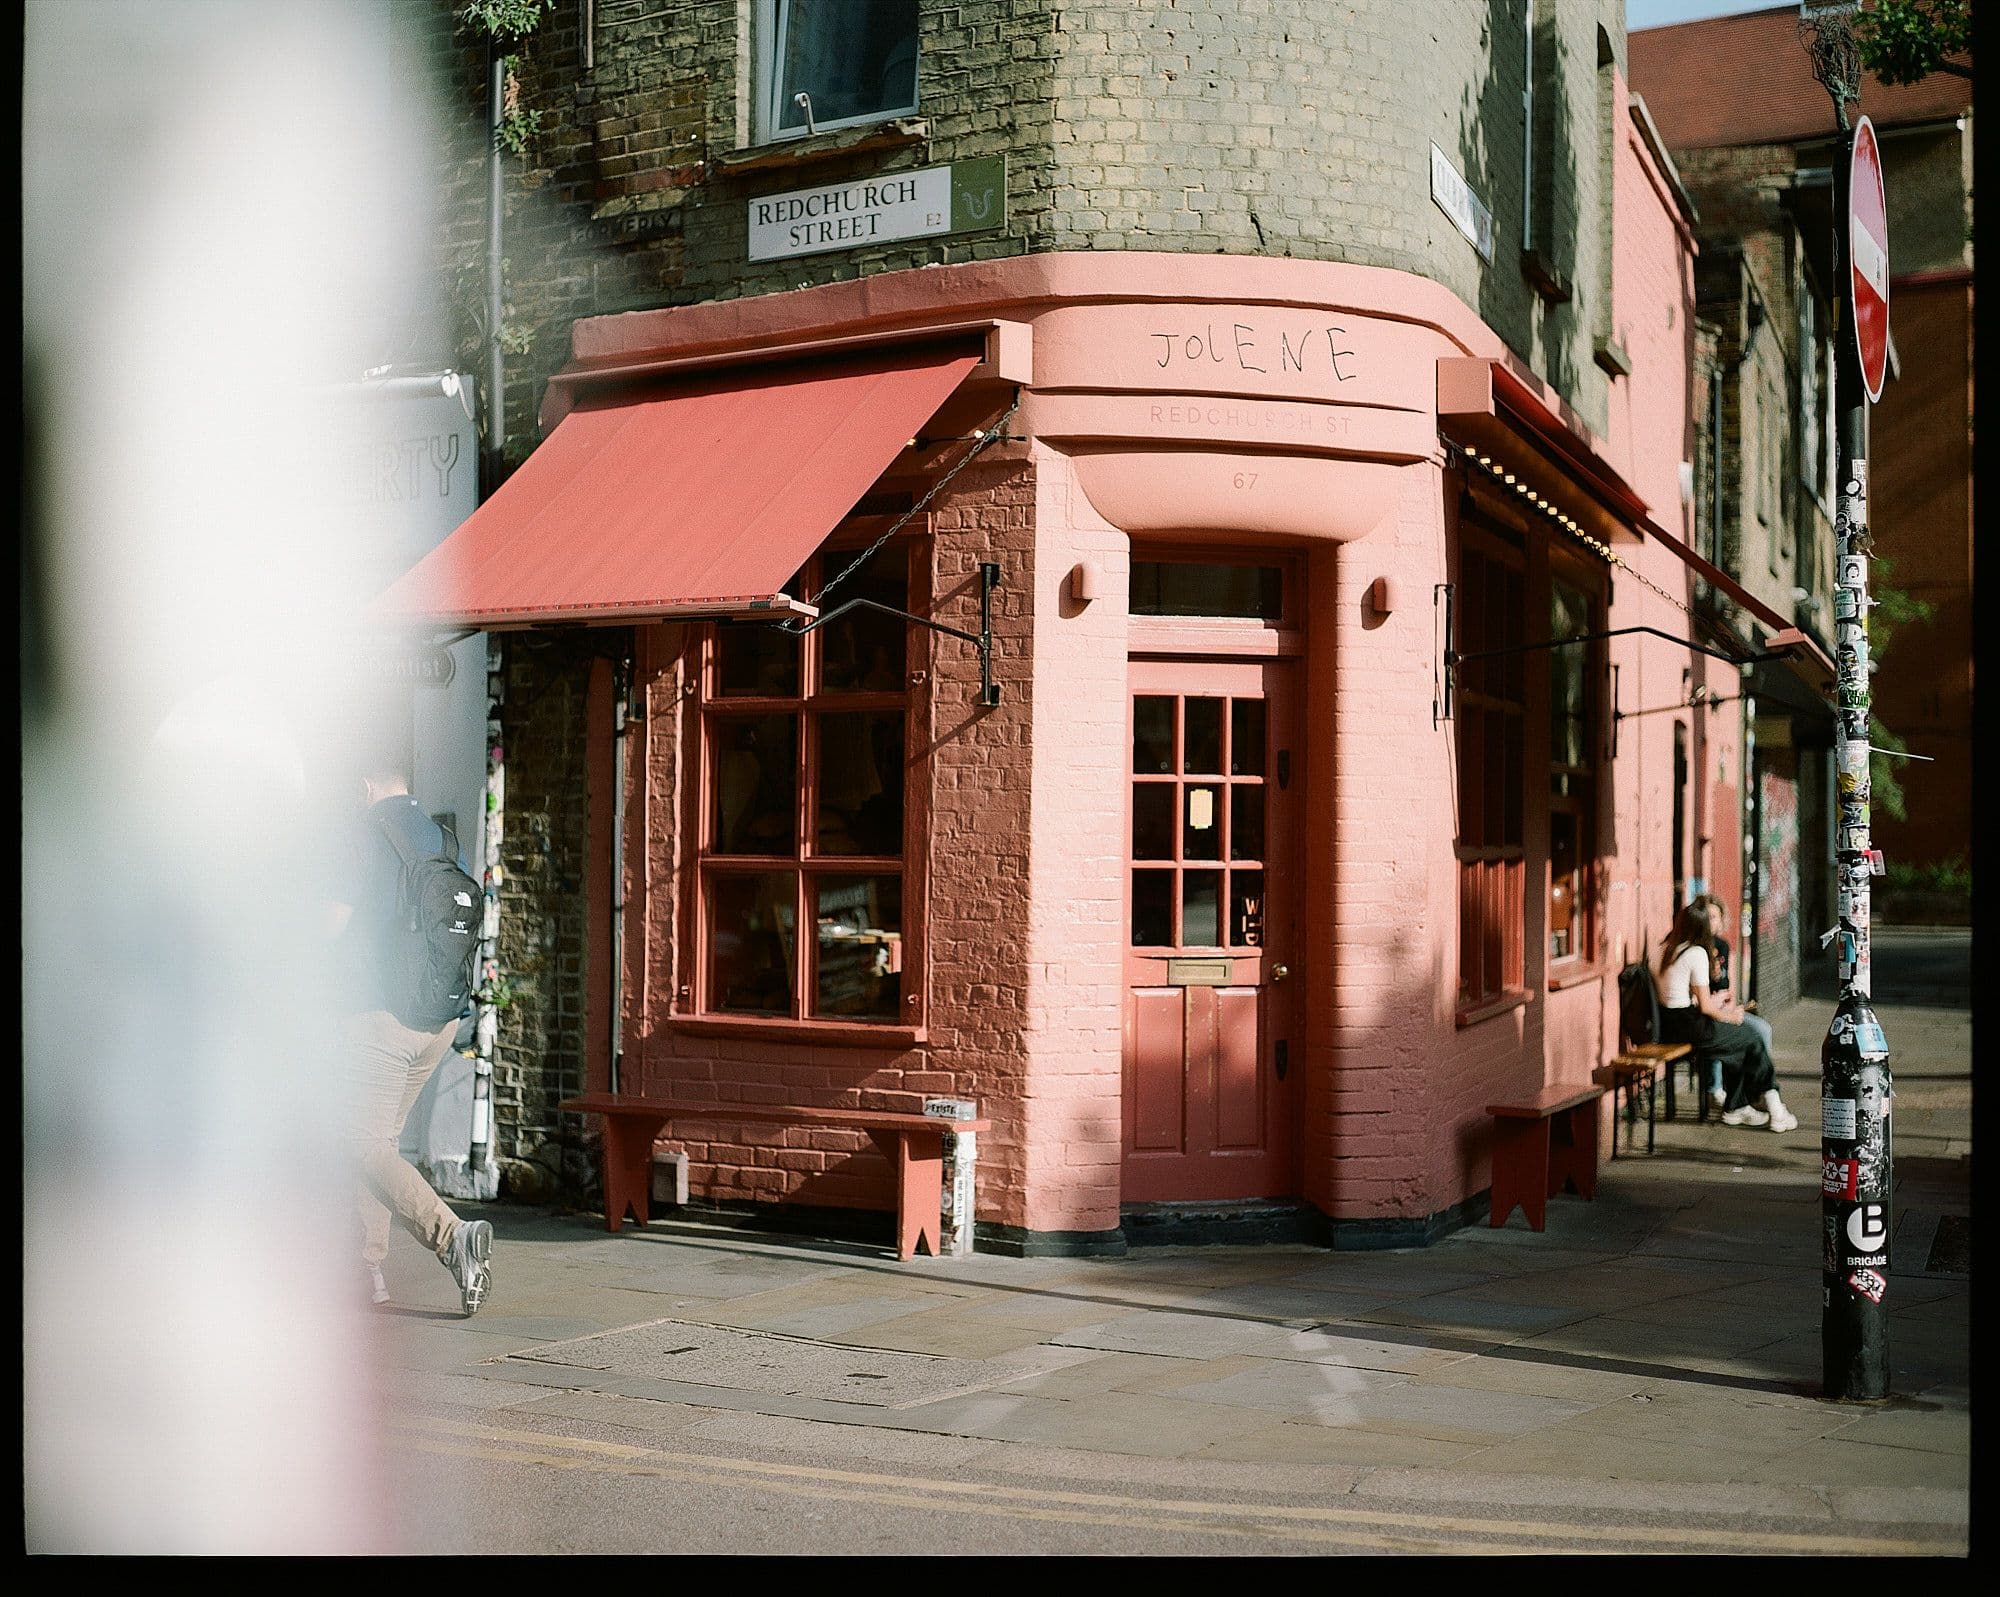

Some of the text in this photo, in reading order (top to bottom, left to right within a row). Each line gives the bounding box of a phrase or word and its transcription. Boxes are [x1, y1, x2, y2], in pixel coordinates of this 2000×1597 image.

[758, 179, 917, 226] REDCHURCH
[789, 213, 882, 248] STREET
[926, 213, 942, 227] E2
[1150, 405, 1352, 434] REDCHURCH ST
[1233, 472, 1258, 490] 67
[1847, 1255, 1887, 1267] BRIGADE
